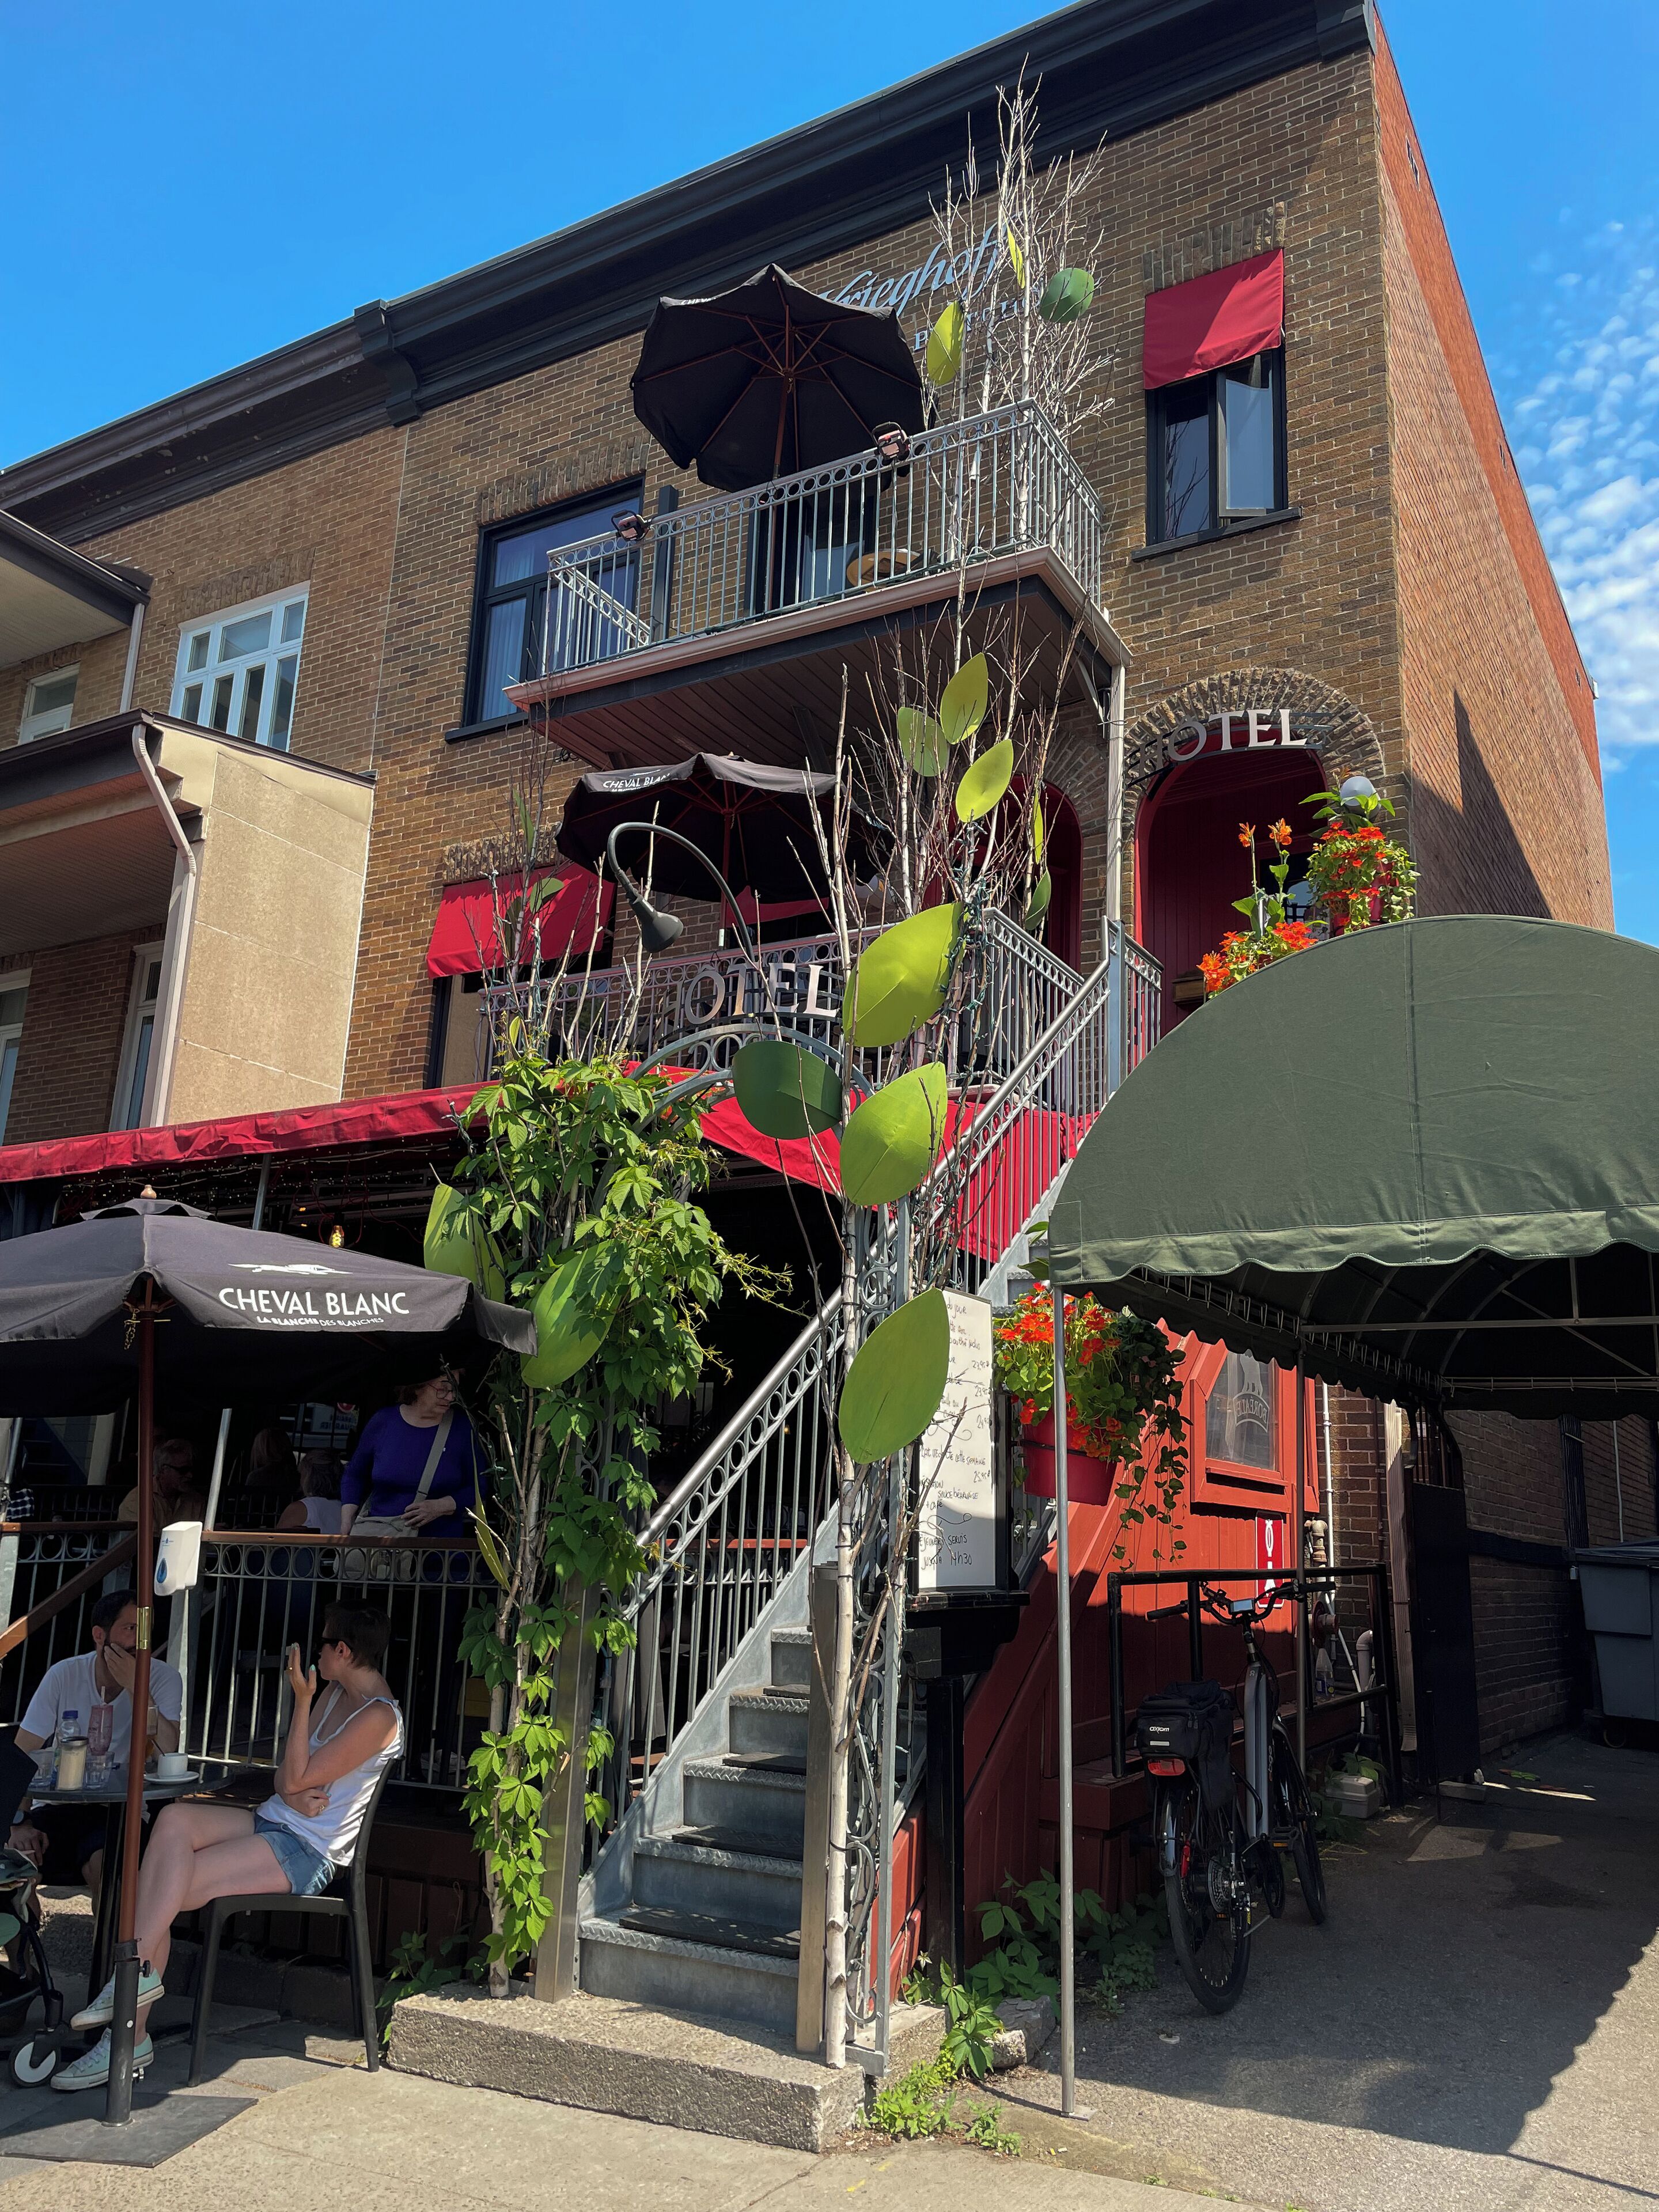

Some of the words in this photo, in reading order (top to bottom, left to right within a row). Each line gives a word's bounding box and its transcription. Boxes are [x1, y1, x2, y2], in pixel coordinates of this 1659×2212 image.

[1138, 709, 1308, 778] HÔTEL
[603, 778, 641, 789] CHEVAL
[655, 963, 839, 1039] HÔTEL
[218, 1287, 319, 1315] CHEVAL
[325, 1292, 410, 1316] BLANC
[337, 1317, 384, 1327] BLANCHES
